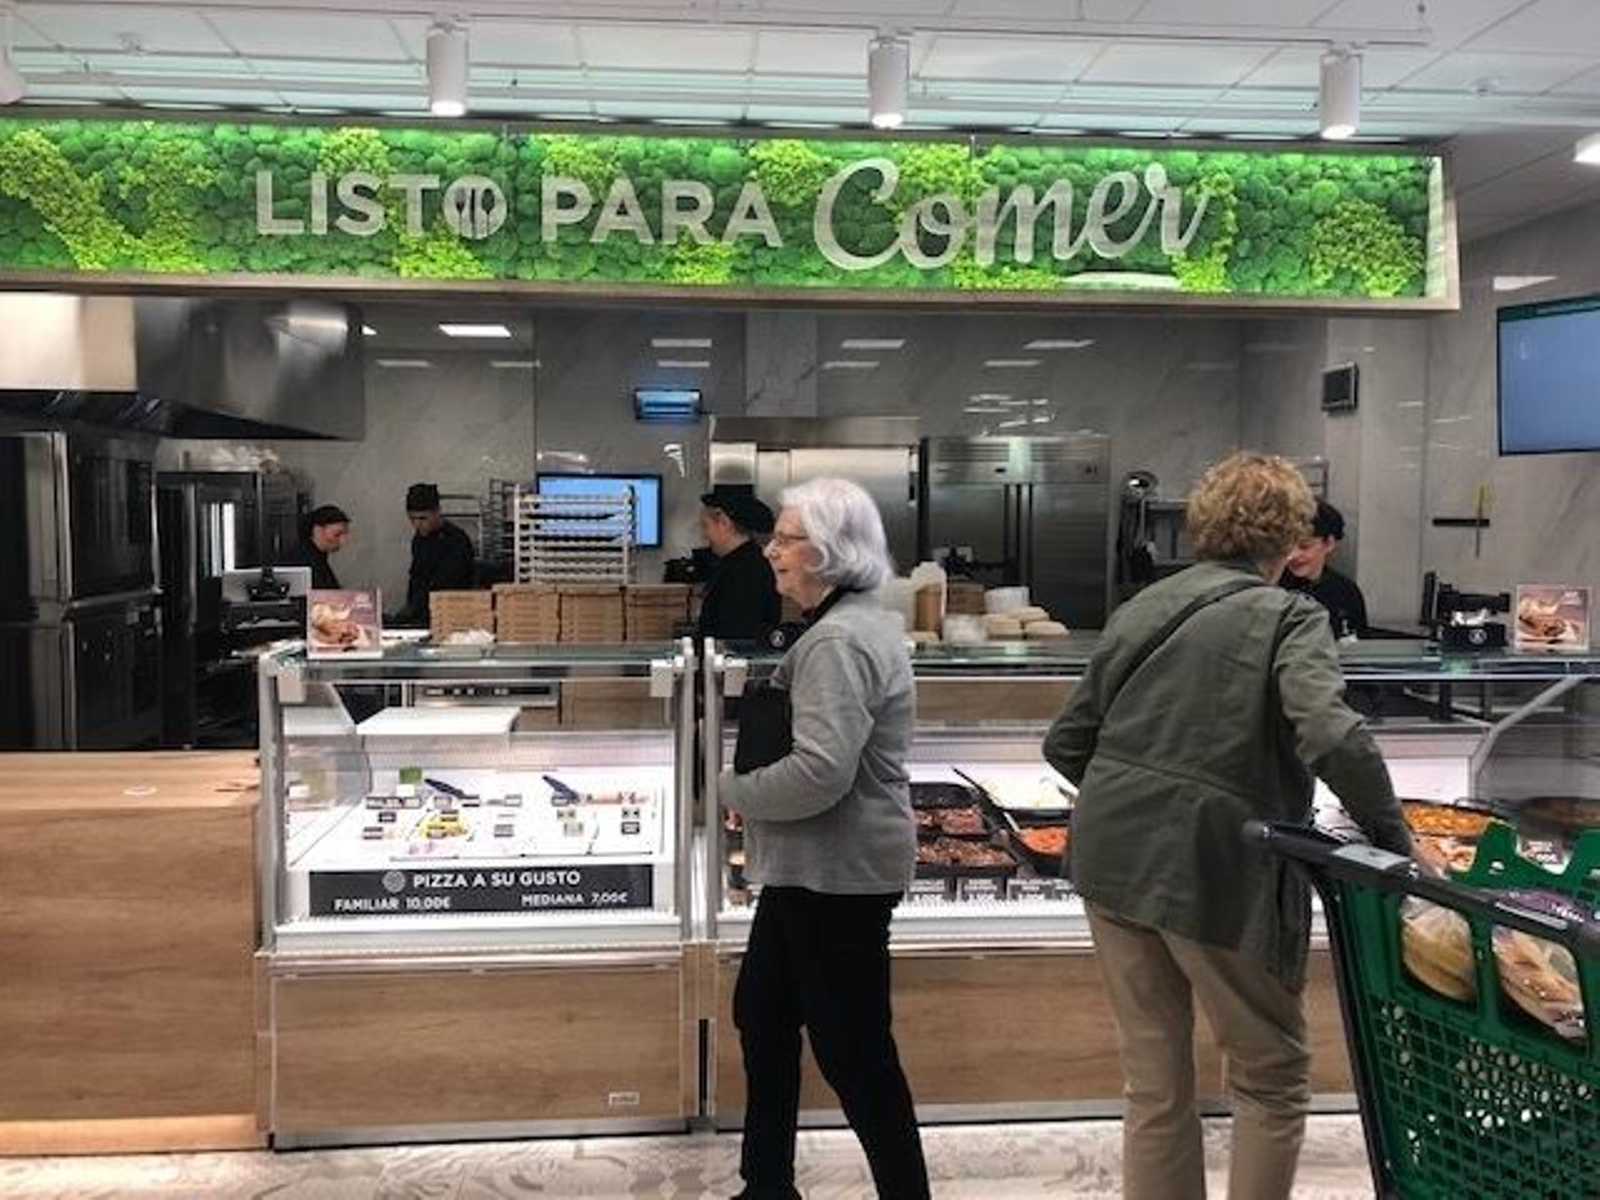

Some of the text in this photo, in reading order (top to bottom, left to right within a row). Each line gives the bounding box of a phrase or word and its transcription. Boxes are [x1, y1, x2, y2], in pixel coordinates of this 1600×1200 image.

[256, 157, 1214, 271] LISTO PARA Comer
[413, 871, 581, 888] PIZZA A SU GUSTO
[333, 898, 400, 911] FAMILIAR
[521, 893, 585, 907] MEDIANA
